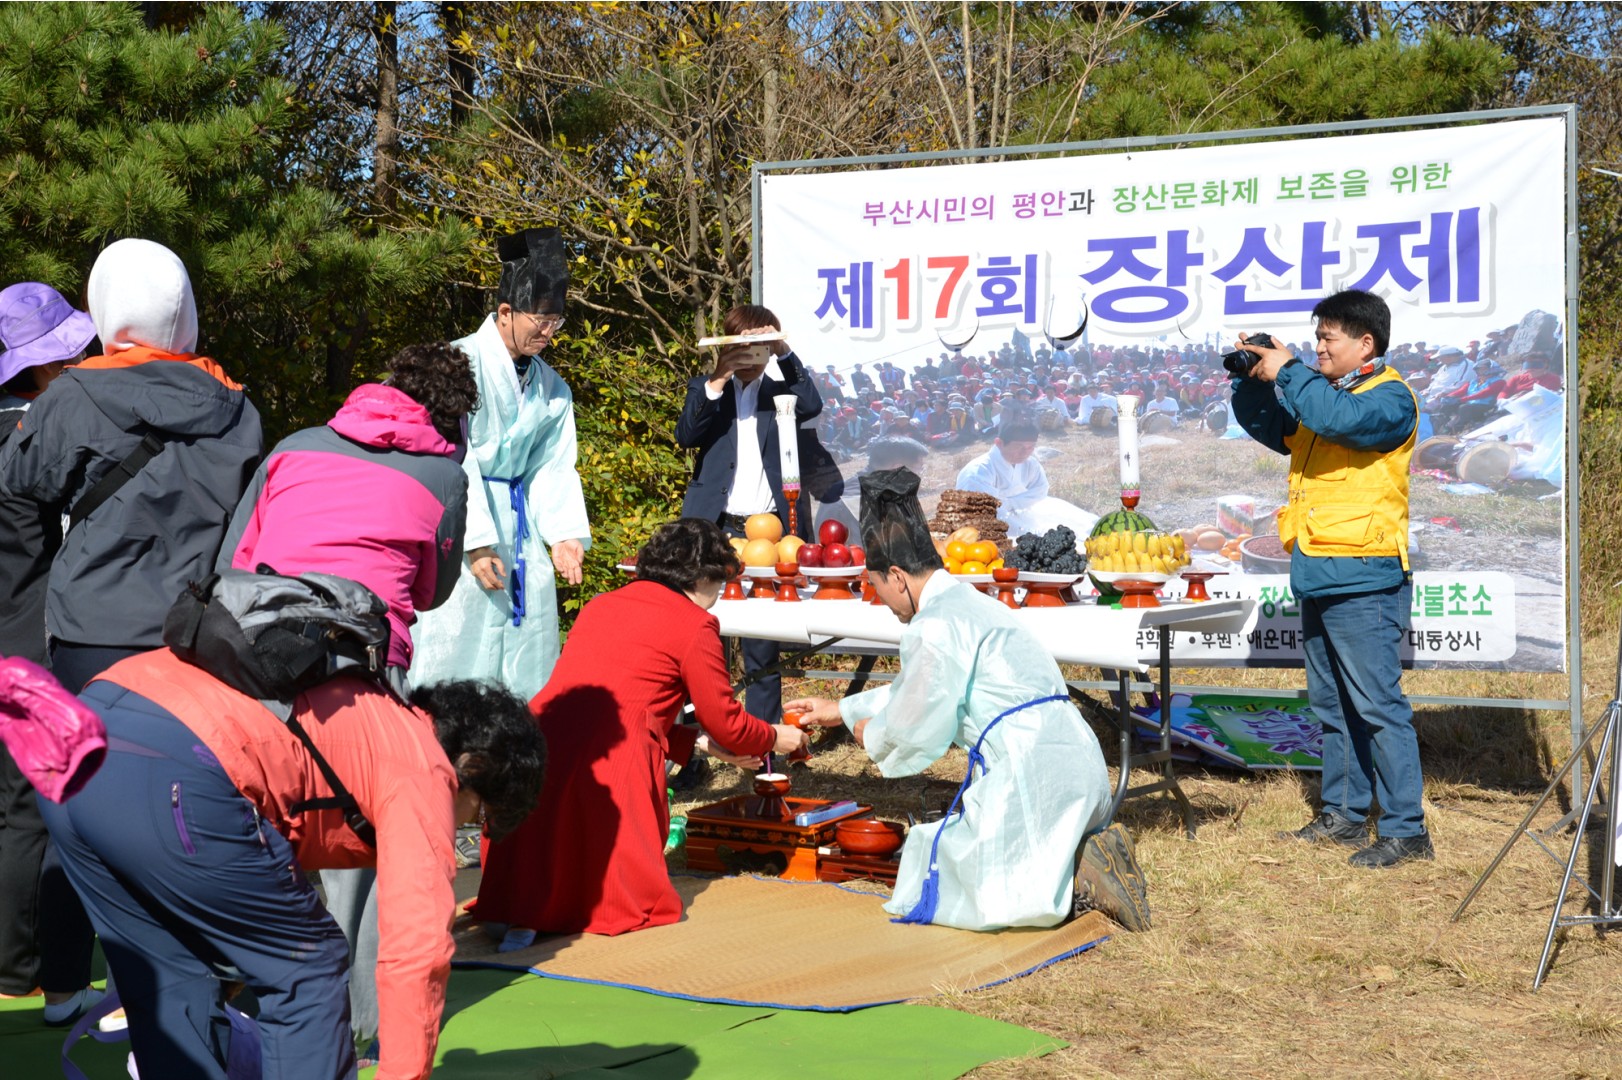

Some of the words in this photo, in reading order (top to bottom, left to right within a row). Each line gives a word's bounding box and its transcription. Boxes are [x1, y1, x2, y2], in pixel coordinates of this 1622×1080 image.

[863, 195, 994, 227] 부산시민의
[1012, 189, 1095, 219] 평안과
[1112, 177, 1259, 213] 장산문화제
[1276, 168, 1370, 200] 보존을
[1390, 162, 1453, 193] 위한
[814, 254, 1038, 329] 제17회
[1078, 206, 1481, 324] 장산제
[1408, 630, 1482, 652] 대동상사
